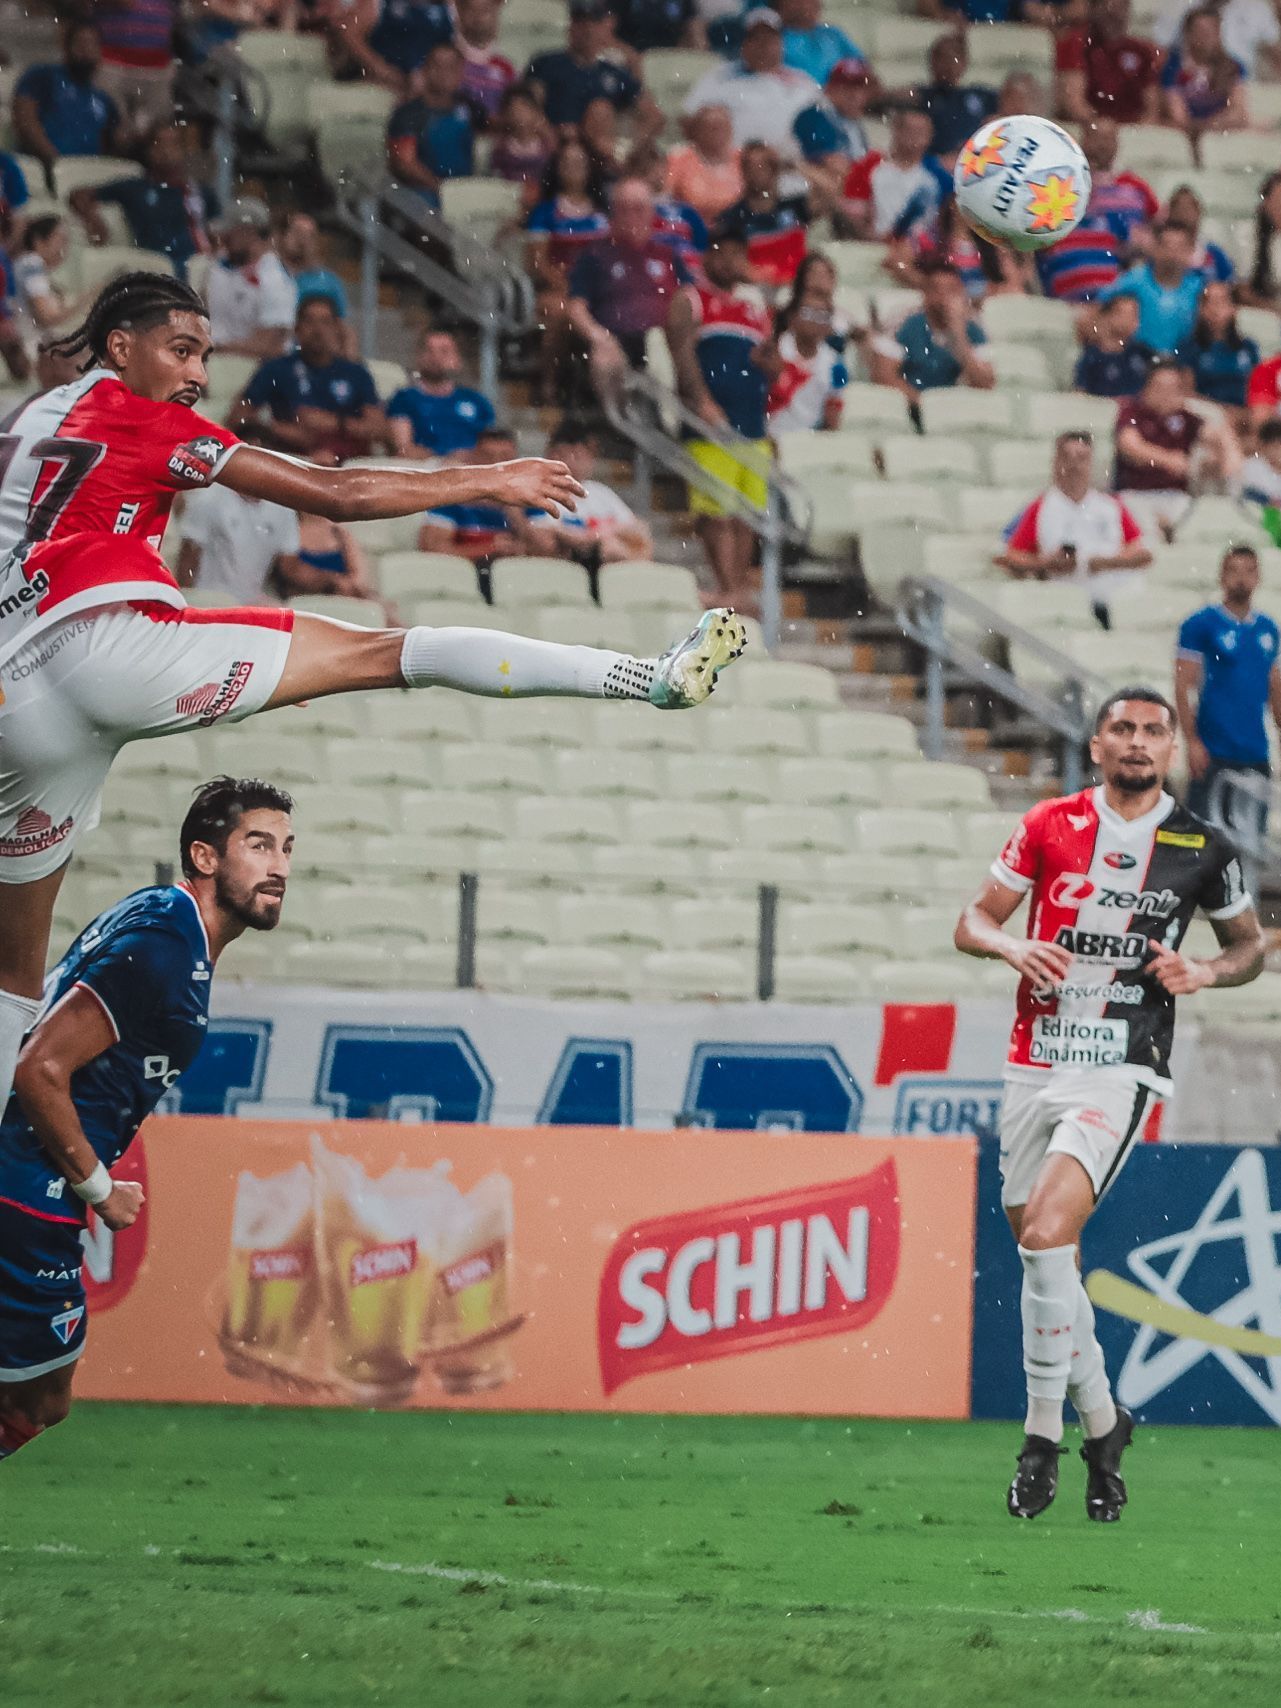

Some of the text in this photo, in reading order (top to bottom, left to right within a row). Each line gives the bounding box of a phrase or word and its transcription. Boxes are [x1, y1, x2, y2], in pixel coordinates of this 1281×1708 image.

[992, 137, 1040, 218] PENALTY
[168, 457, 183, 473] DA
[1053, 928, 1146, 958] ABRO
[1041, 1017, 1114, 1041] Editora
[617, 1206, 870, 1352] SCHIN
